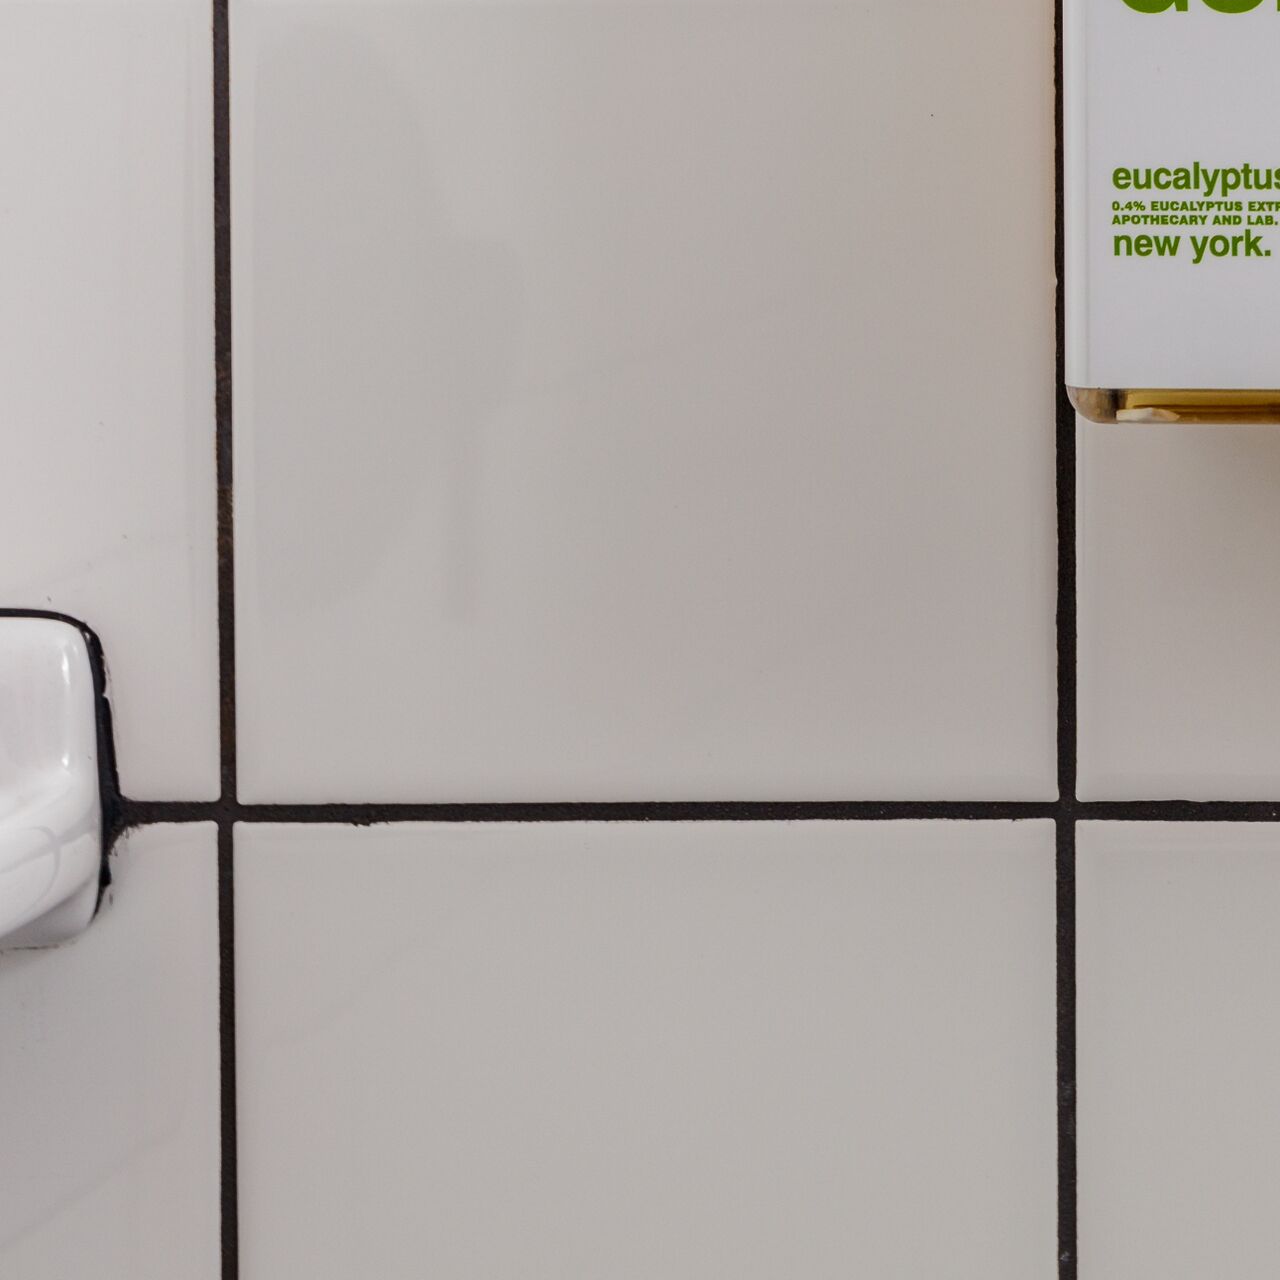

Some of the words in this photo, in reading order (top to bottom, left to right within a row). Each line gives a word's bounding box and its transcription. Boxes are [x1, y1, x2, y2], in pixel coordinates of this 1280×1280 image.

[1112, 201, 1146, 212] 0.4%
[1150, 201, 1243, 212] EUCALYPTUS
[1112, 215, 1207, 226] APOTHECARY
[1212, 215, 1242, 226] AND
[1246, 215, 1278, 226] LAB.
[1113, 234, 1182, 257] new
[1190, 229, 1272, 264] york.
